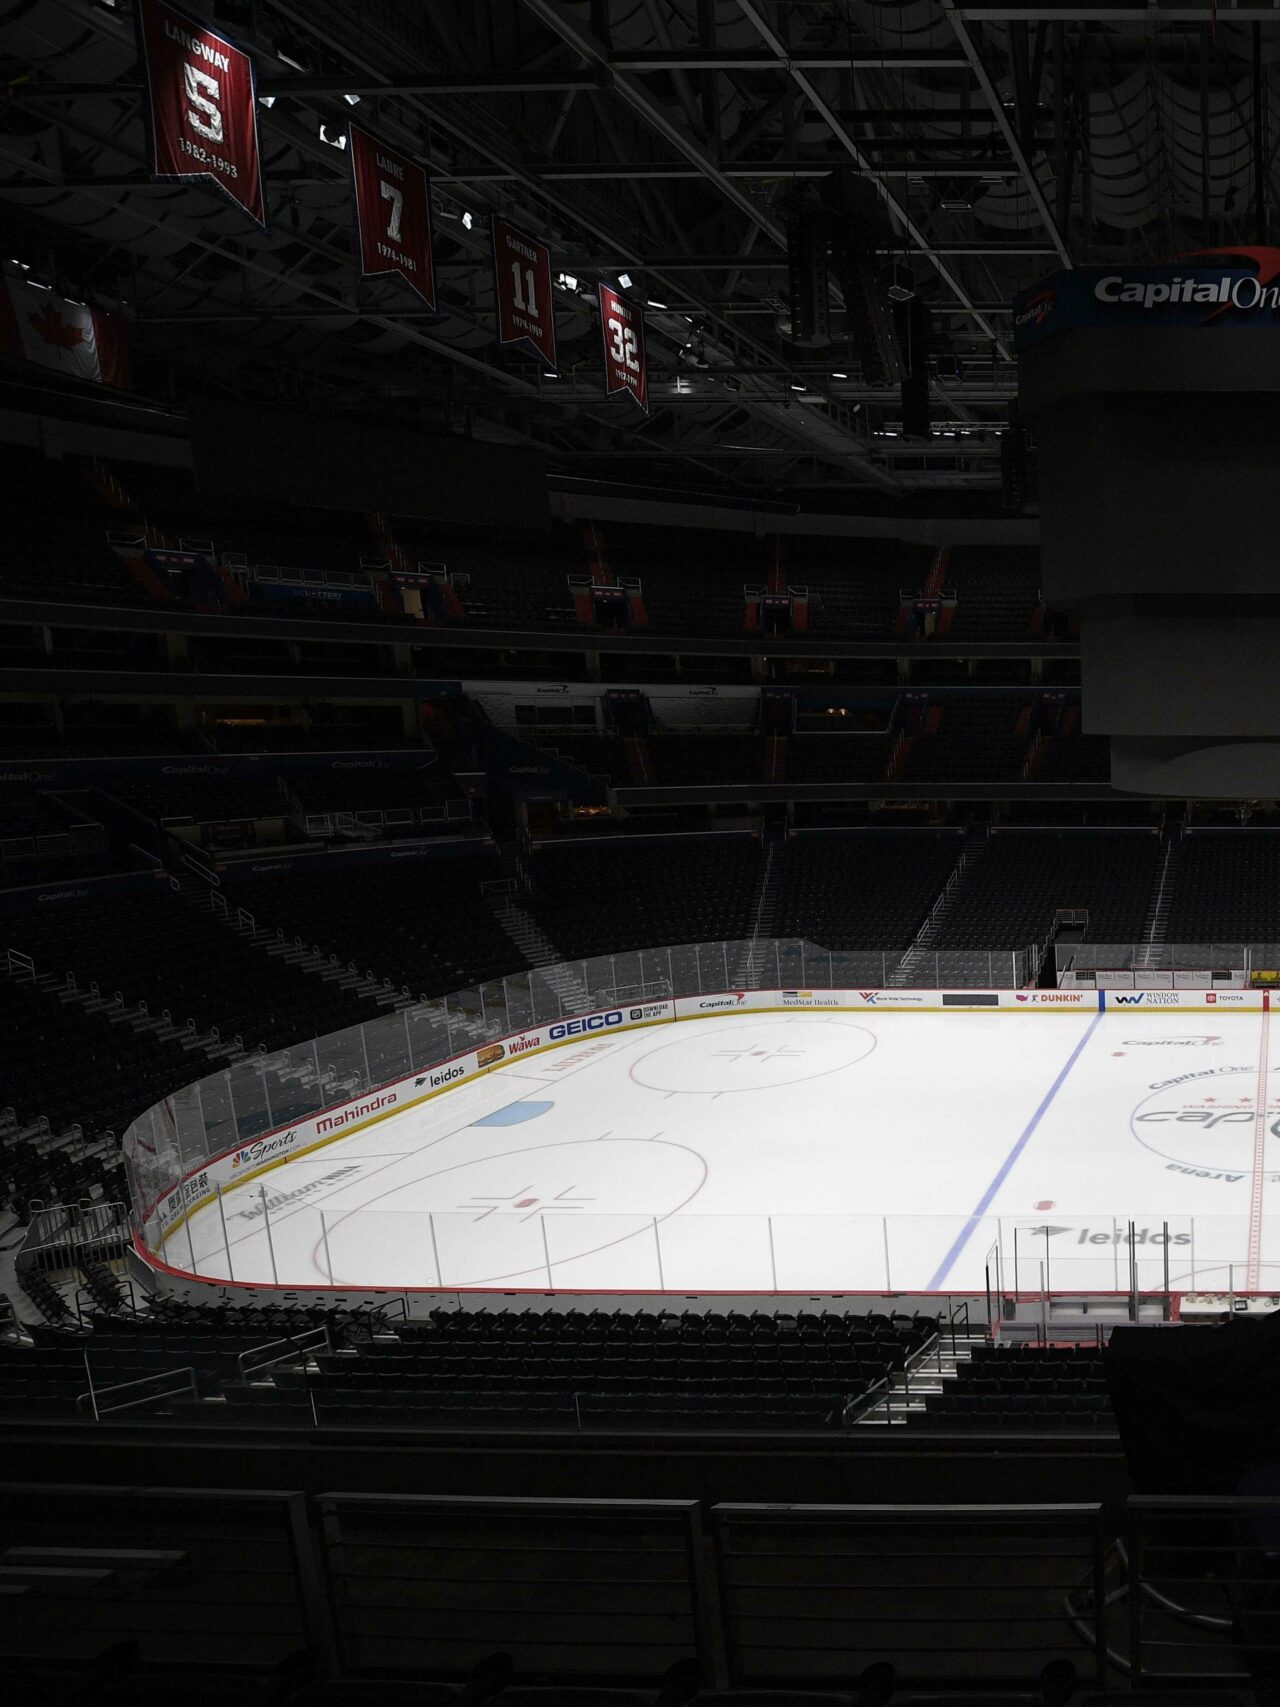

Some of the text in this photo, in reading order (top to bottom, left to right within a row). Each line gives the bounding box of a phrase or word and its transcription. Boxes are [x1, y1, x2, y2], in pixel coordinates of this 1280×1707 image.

[164, 20, 230, 73] LANGWAY
[183, 61, 224, 144] 5
[178, 137, 239, 179] 1982-1993
[376, 152, 405, 182] LABRE
[380, 180, 404, 244] 7
[511, 261, 539, 319] 11
[608, 317, 640, 373] 32
[643, 1003, 669, 1013] DOWNLOAD
[1041, 994, 1083, 1003] DUNKIN'
[549, 1011, 623, 1040] GEICO
[508, 1036, 540, 1055] Wawa
[430, 1065, 465, 1088] leidos
[316, 1093, 397, 1134] Mahindra
[250, 1130, 298, 1160] Sports
[1165, 1162, 1246, 1183] Arena
[1077, 1228, 1191, 1245] leidos
